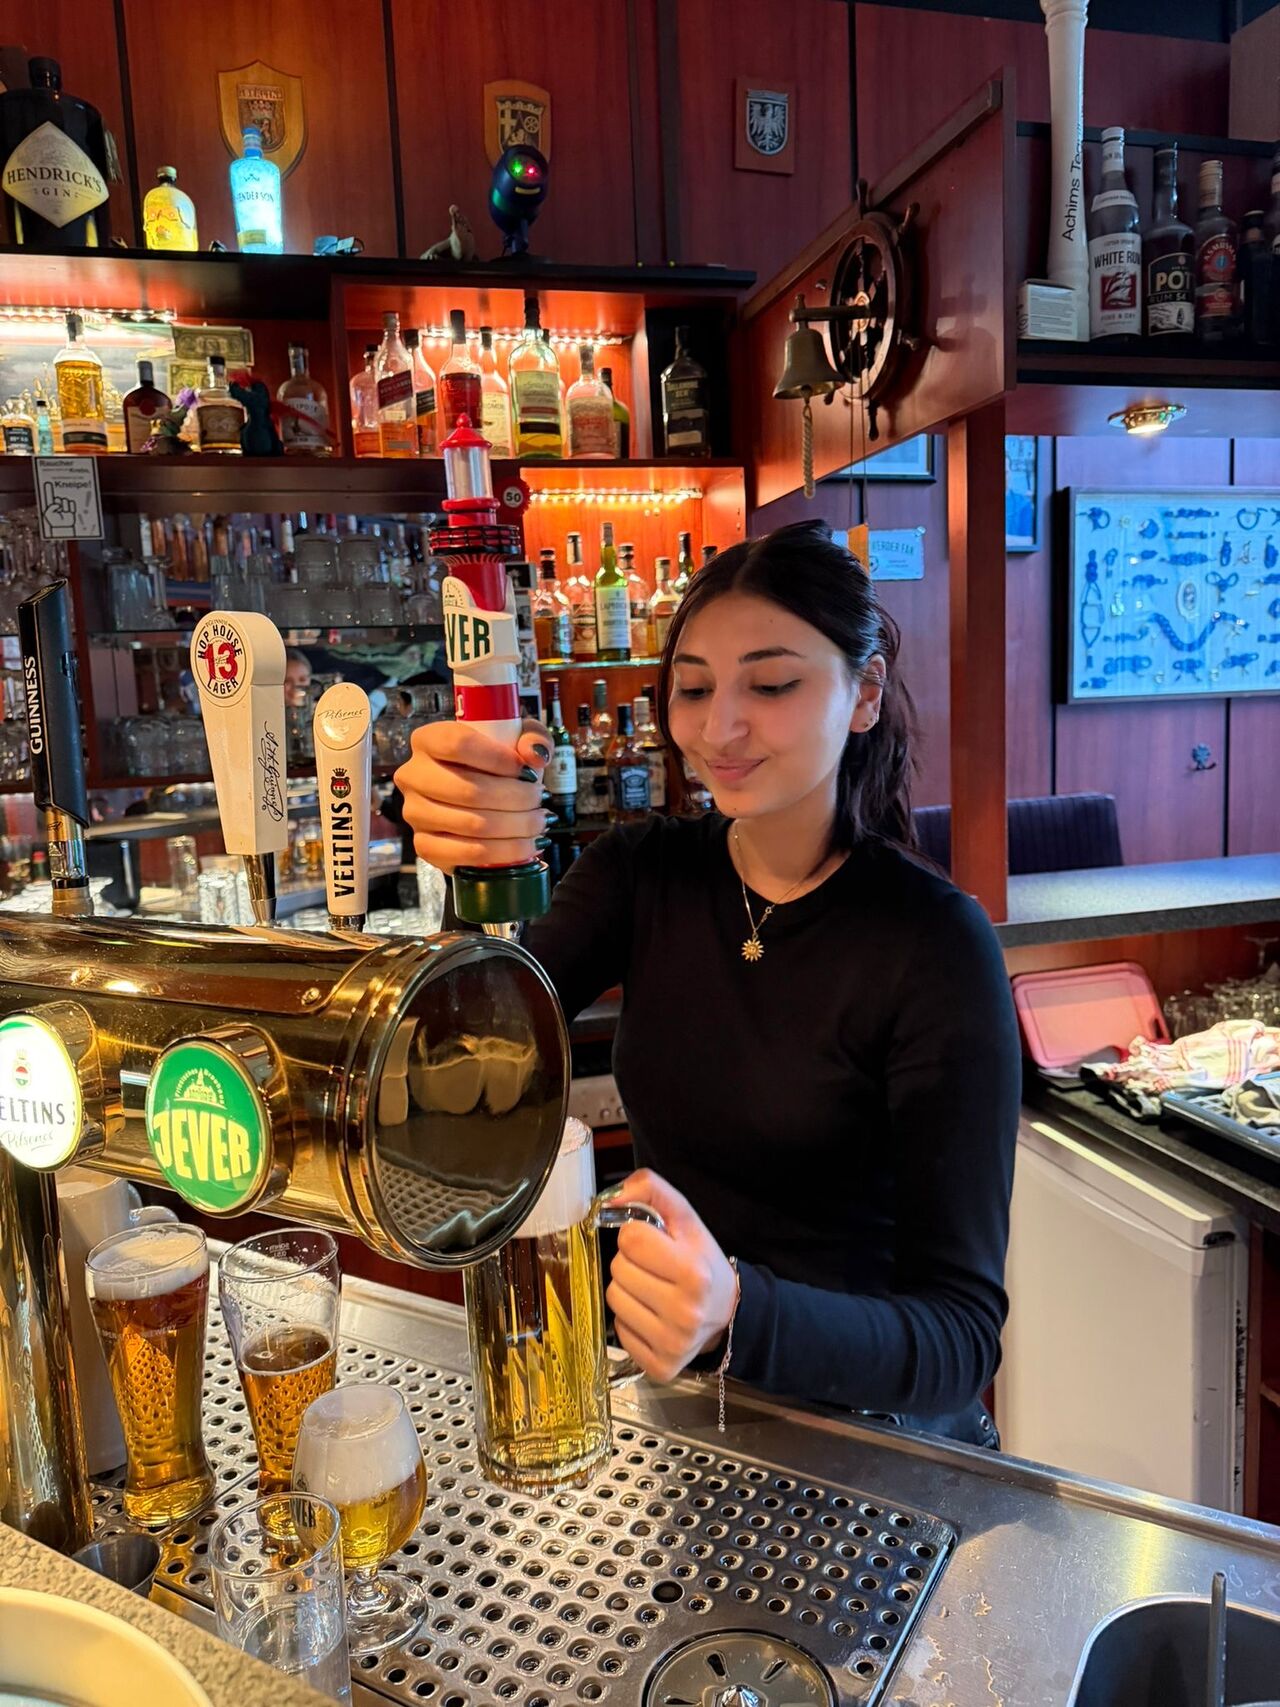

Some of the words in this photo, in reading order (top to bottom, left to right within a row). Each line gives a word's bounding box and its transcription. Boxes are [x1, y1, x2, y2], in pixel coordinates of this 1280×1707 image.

[7, 166, 102, 193] HENDRICK'S
[42, 187, 71, 197] GIN
[1062, 178, 1080, 241] Achims
[1094, 251, 1124, 269] WHITE
[506, 491, 521, 502] 50
[197, 631, 209, 659] HOP
[212, 624, 243, 657] HOUSE
[204, 642, 238, 680] 13
[207, 677, 239, 695] LAGER
[25, 655, 43, 755] GUINNESS
[317, 708, 367, 720] Pilsener
[331, 802, 355, 898] VELTINS
[153, 1108, 251, 1182] JEVER
